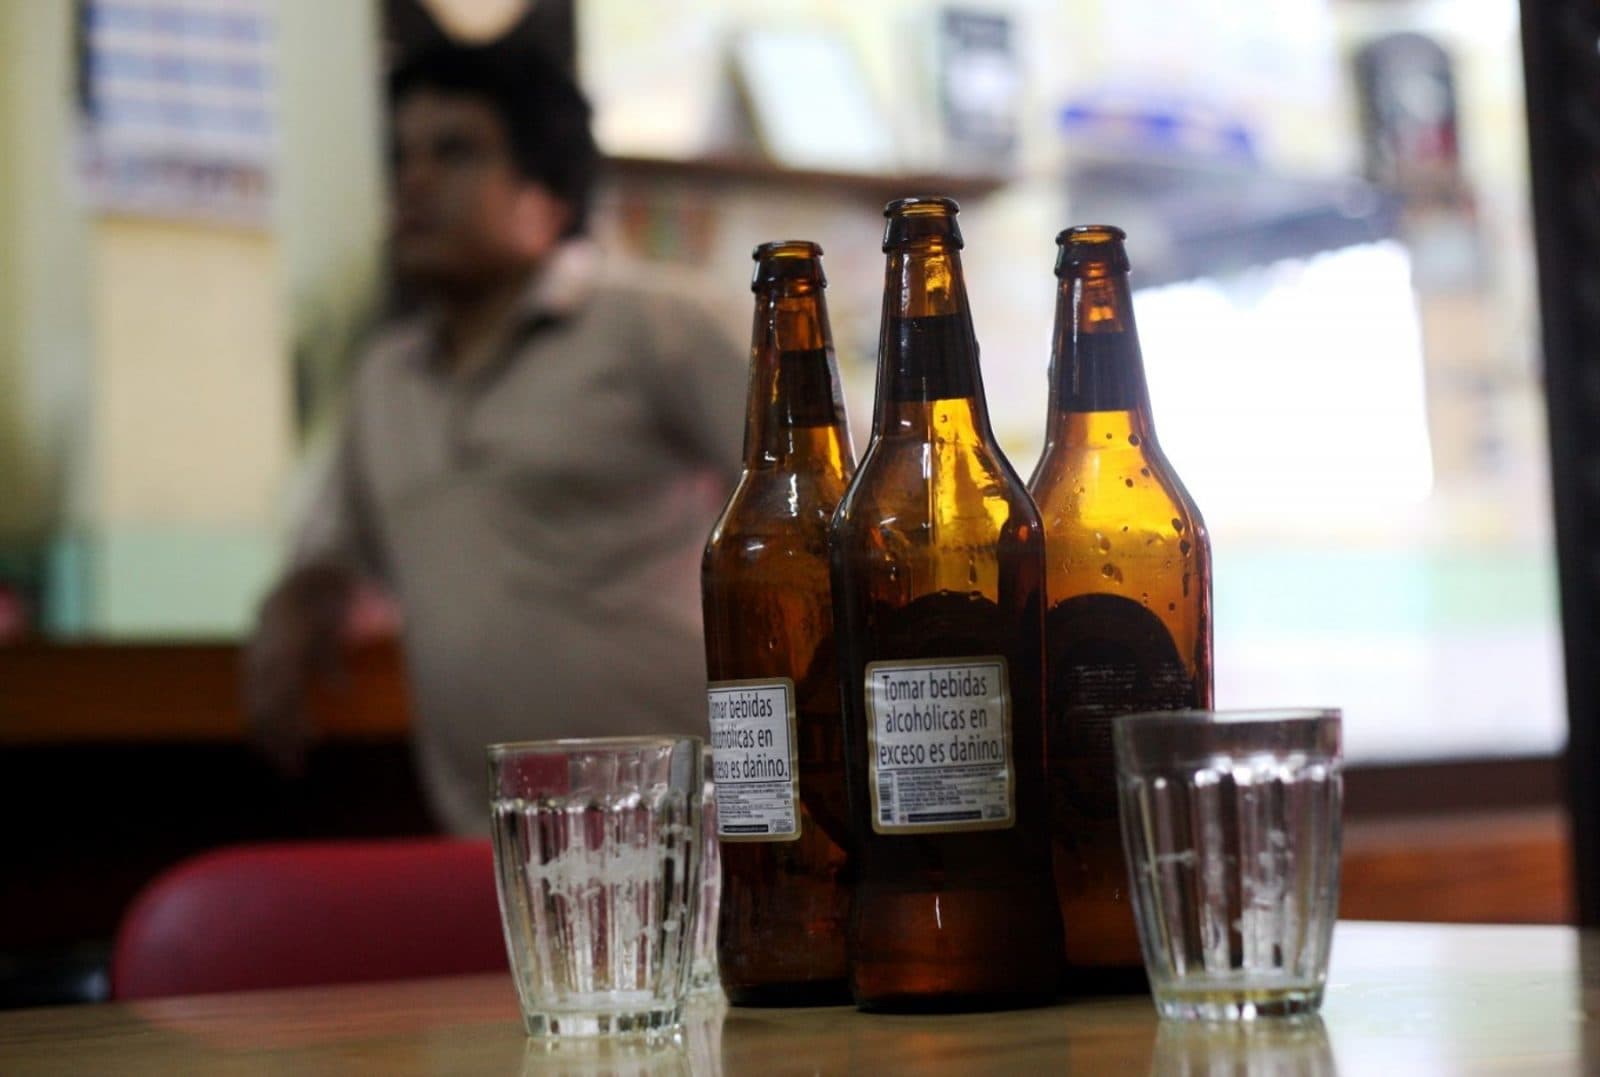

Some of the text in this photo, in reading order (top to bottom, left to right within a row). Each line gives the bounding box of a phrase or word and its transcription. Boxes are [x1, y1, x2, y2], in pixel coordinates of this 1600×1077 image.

[882, 670, 988, 701] Tomar bebidas
[729, 692, 773, 719] bebidas
[885, 704, 987, 733] alcohólicas en
[758, 728, 773, 748] en
[880, 734, 1002, 765] exceso es dañino.
[730, 760, 741, 779] es
[743, 751, 788, 779] dañino.
